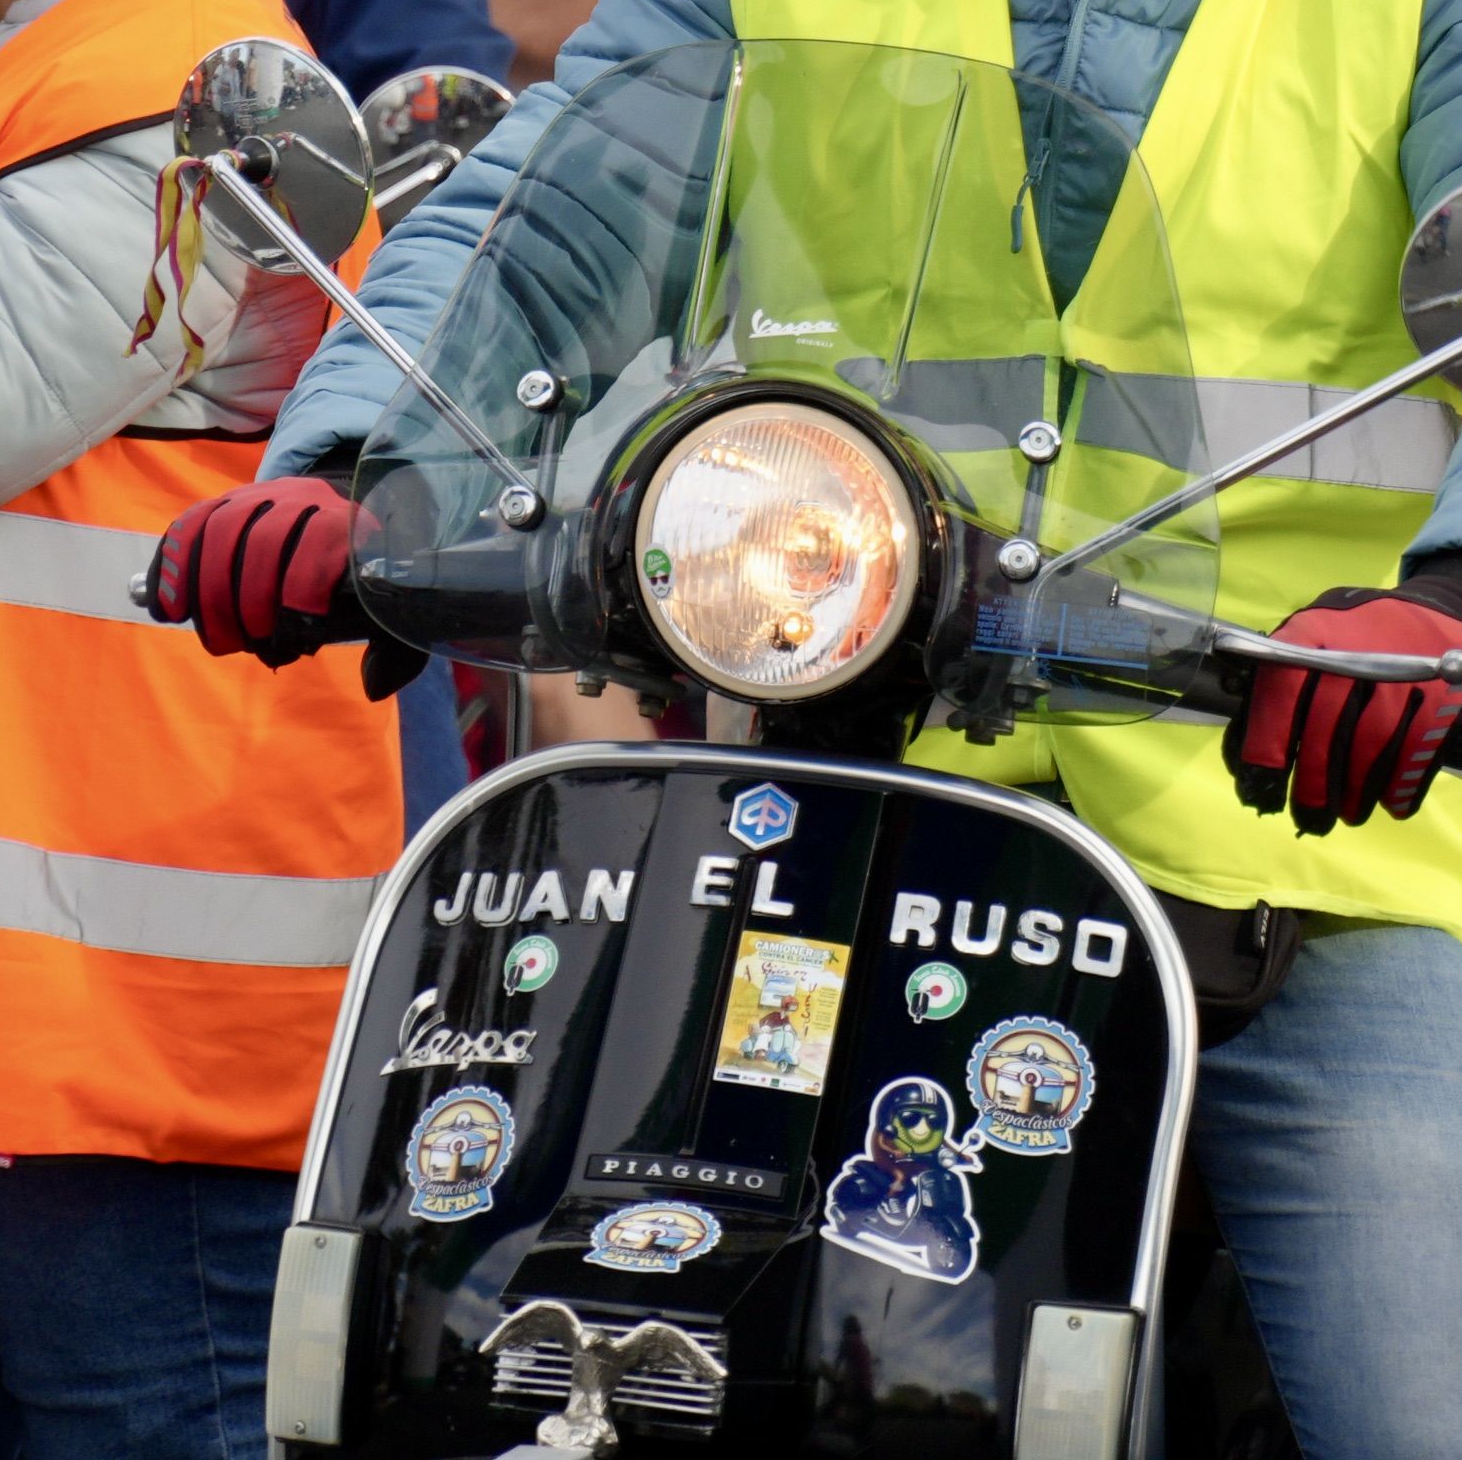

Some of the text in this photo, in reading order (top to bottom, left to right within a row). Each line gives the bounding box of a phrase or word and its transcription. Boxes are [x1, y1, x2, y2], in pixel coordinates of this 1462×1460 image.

[748, 308, 839, 339] Vespa
[434, 854, 1128, 979] JUAN EL RUSO
[380, 987, 537, 1076] Vespa
[987, 1121, 1057, 1147] ZAFRA
[602, 1159, 765, 1190] PIAGGIO
[421, 1193, 480, 1214] ZAFRA
